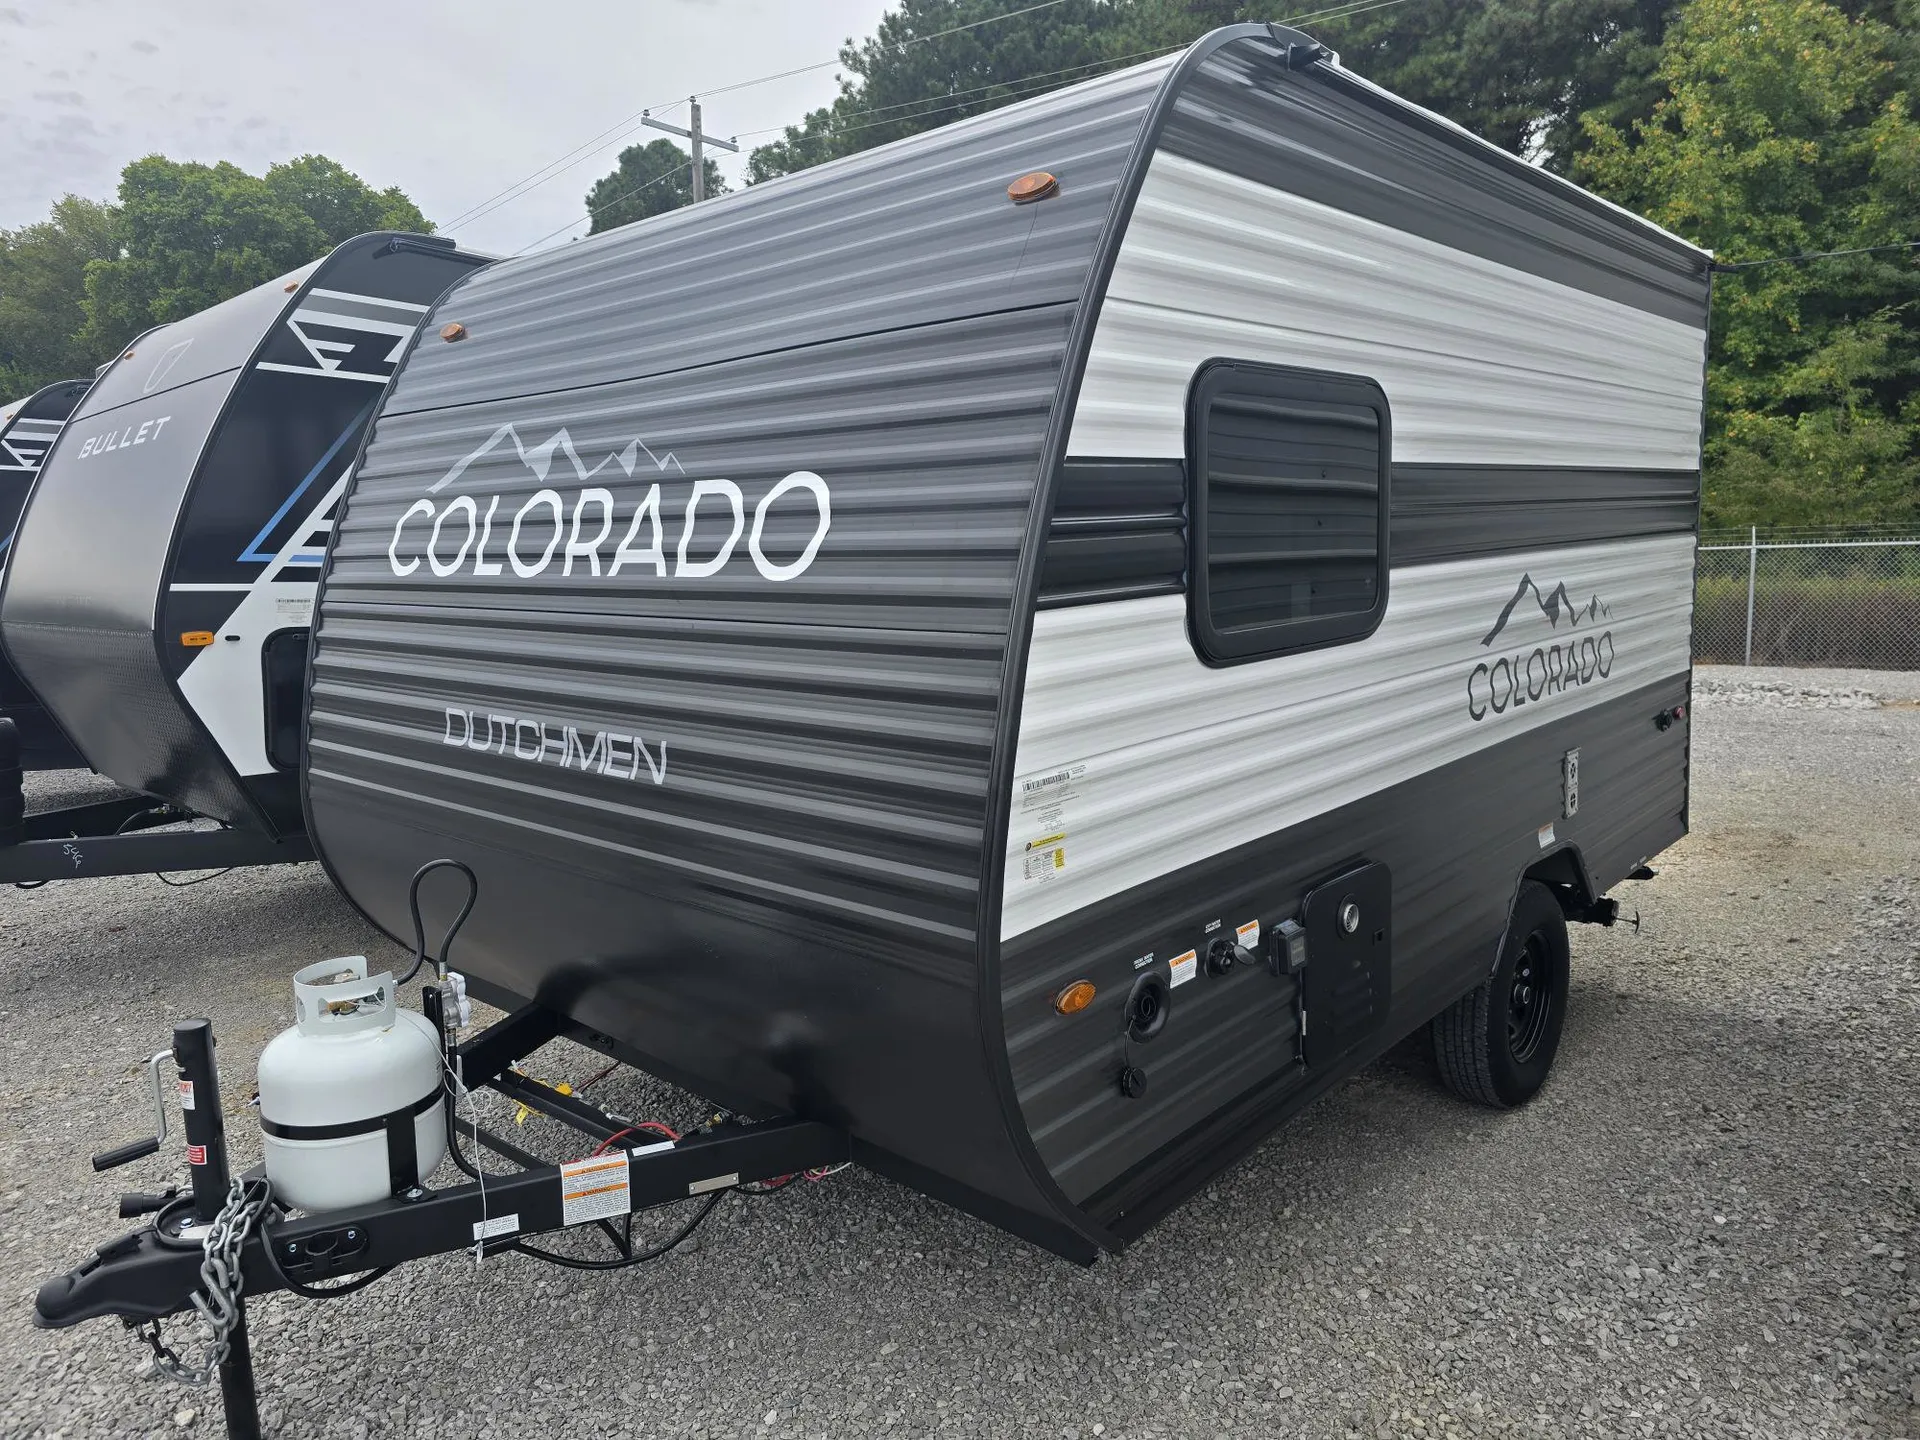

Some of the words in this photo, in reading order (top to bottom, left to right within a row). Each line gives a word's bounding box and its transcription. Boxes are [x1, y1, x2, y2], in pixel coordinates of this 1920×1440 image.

[77, 416, 171, 460] BULLET
[388, 470, 832, 582] COLORADO
[1467, 631, 1615, 722] COLORADO
[443, 707, 668, 785] DUTCHMEN
